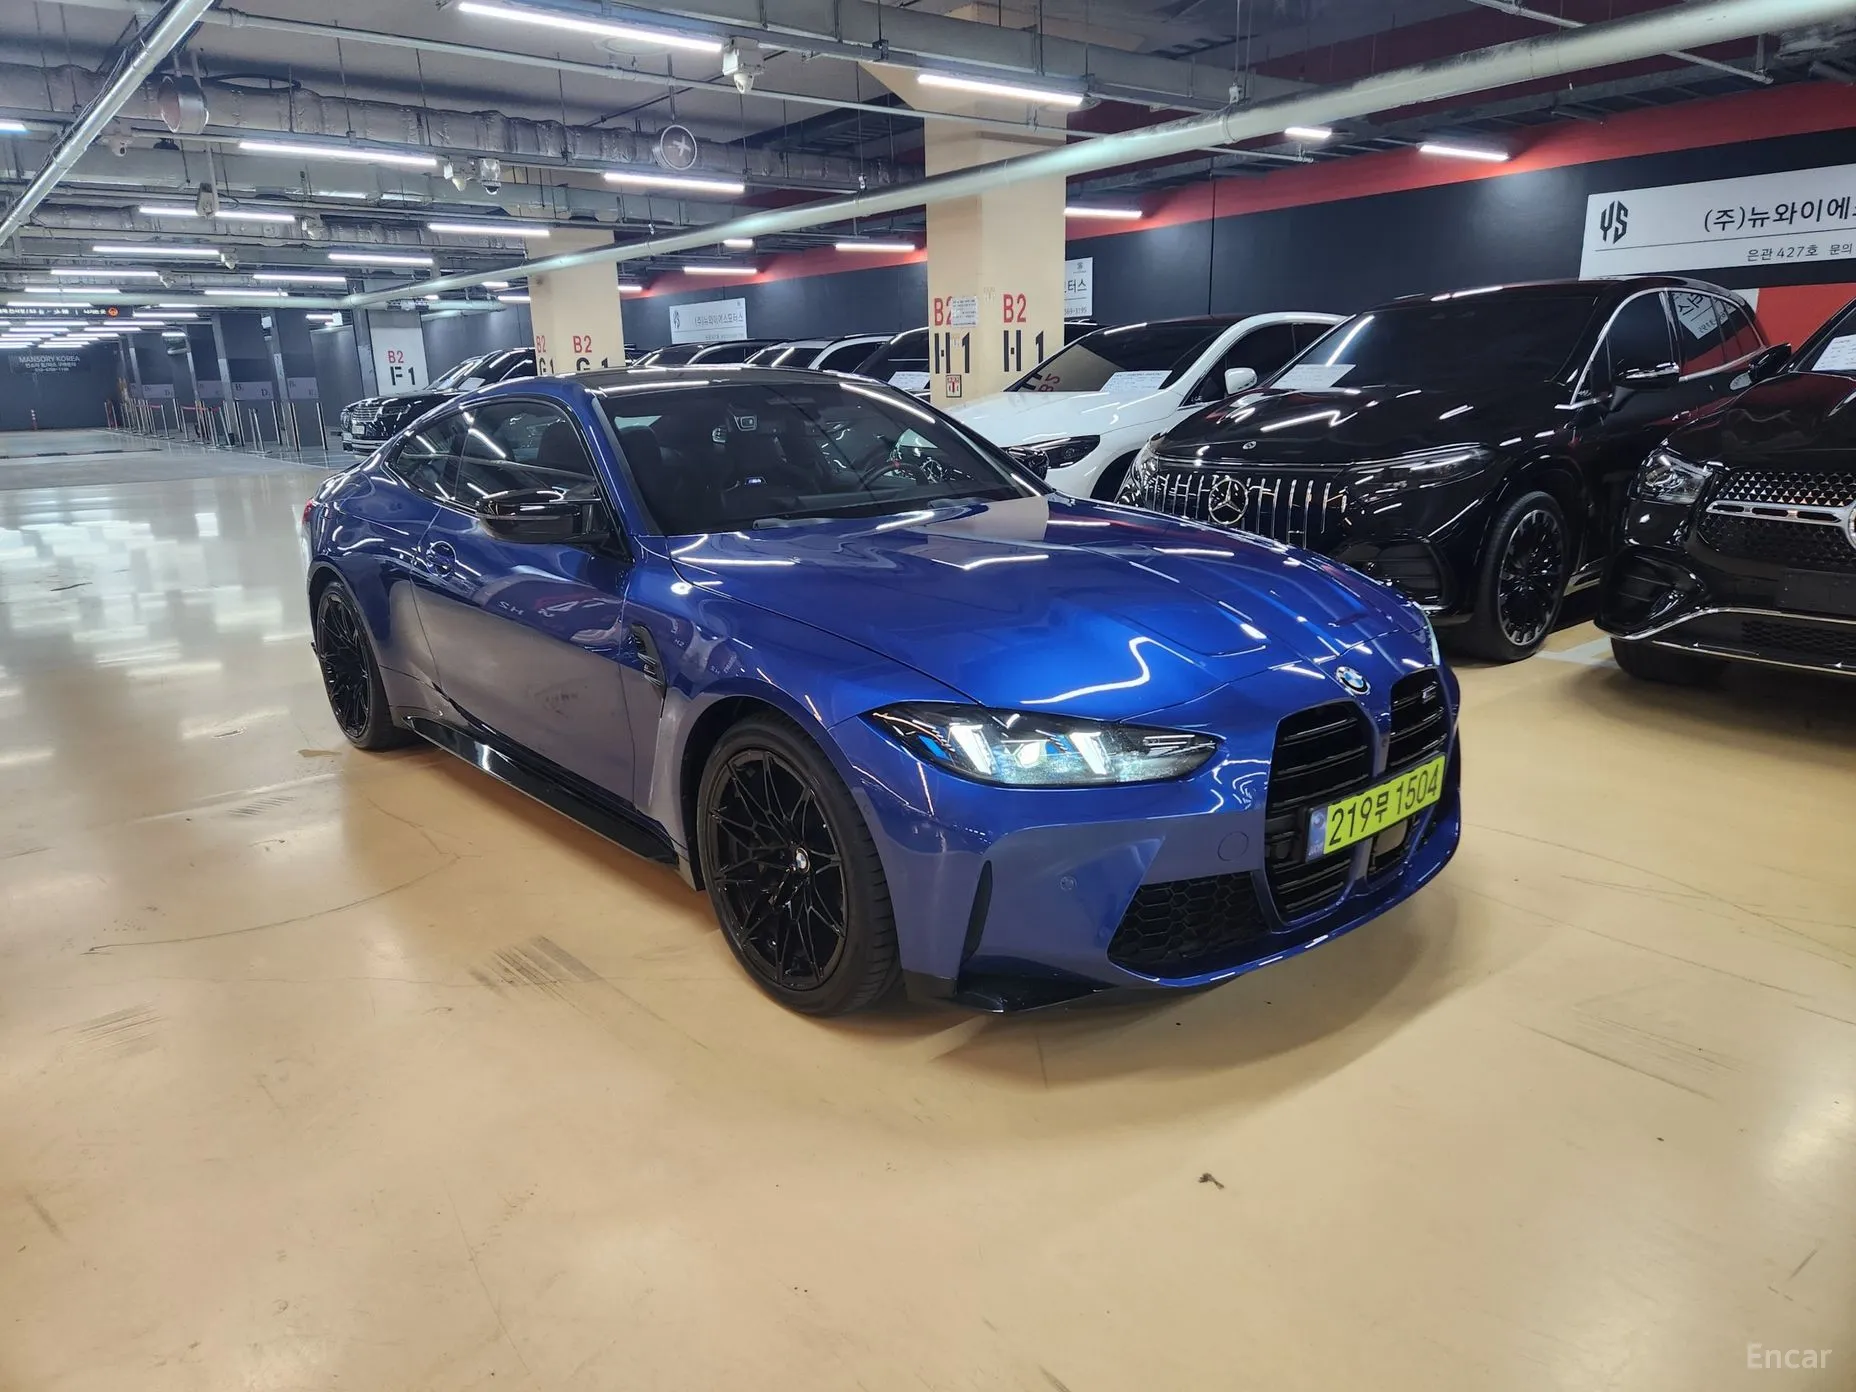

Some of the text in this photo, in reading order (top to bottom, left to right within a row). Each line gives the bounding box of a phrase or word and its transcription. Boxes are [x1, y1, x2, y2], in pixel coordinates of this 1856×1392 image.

[1704, 196, 1856, 232] (주)뉴와이에
[1747, 242, 1853, 262] 은관 427호 문의
[1064, 279, 1087, 294] 터스
[1003, 293, 1027, 323] B2
[536, 335, 546, 353] B2
[573, 335, 592, 353] B2
[387, 350, 404, 363] B2
[390, 366, 415, 385] F1
[1329, 764, 1439, 846] 219무 1504
